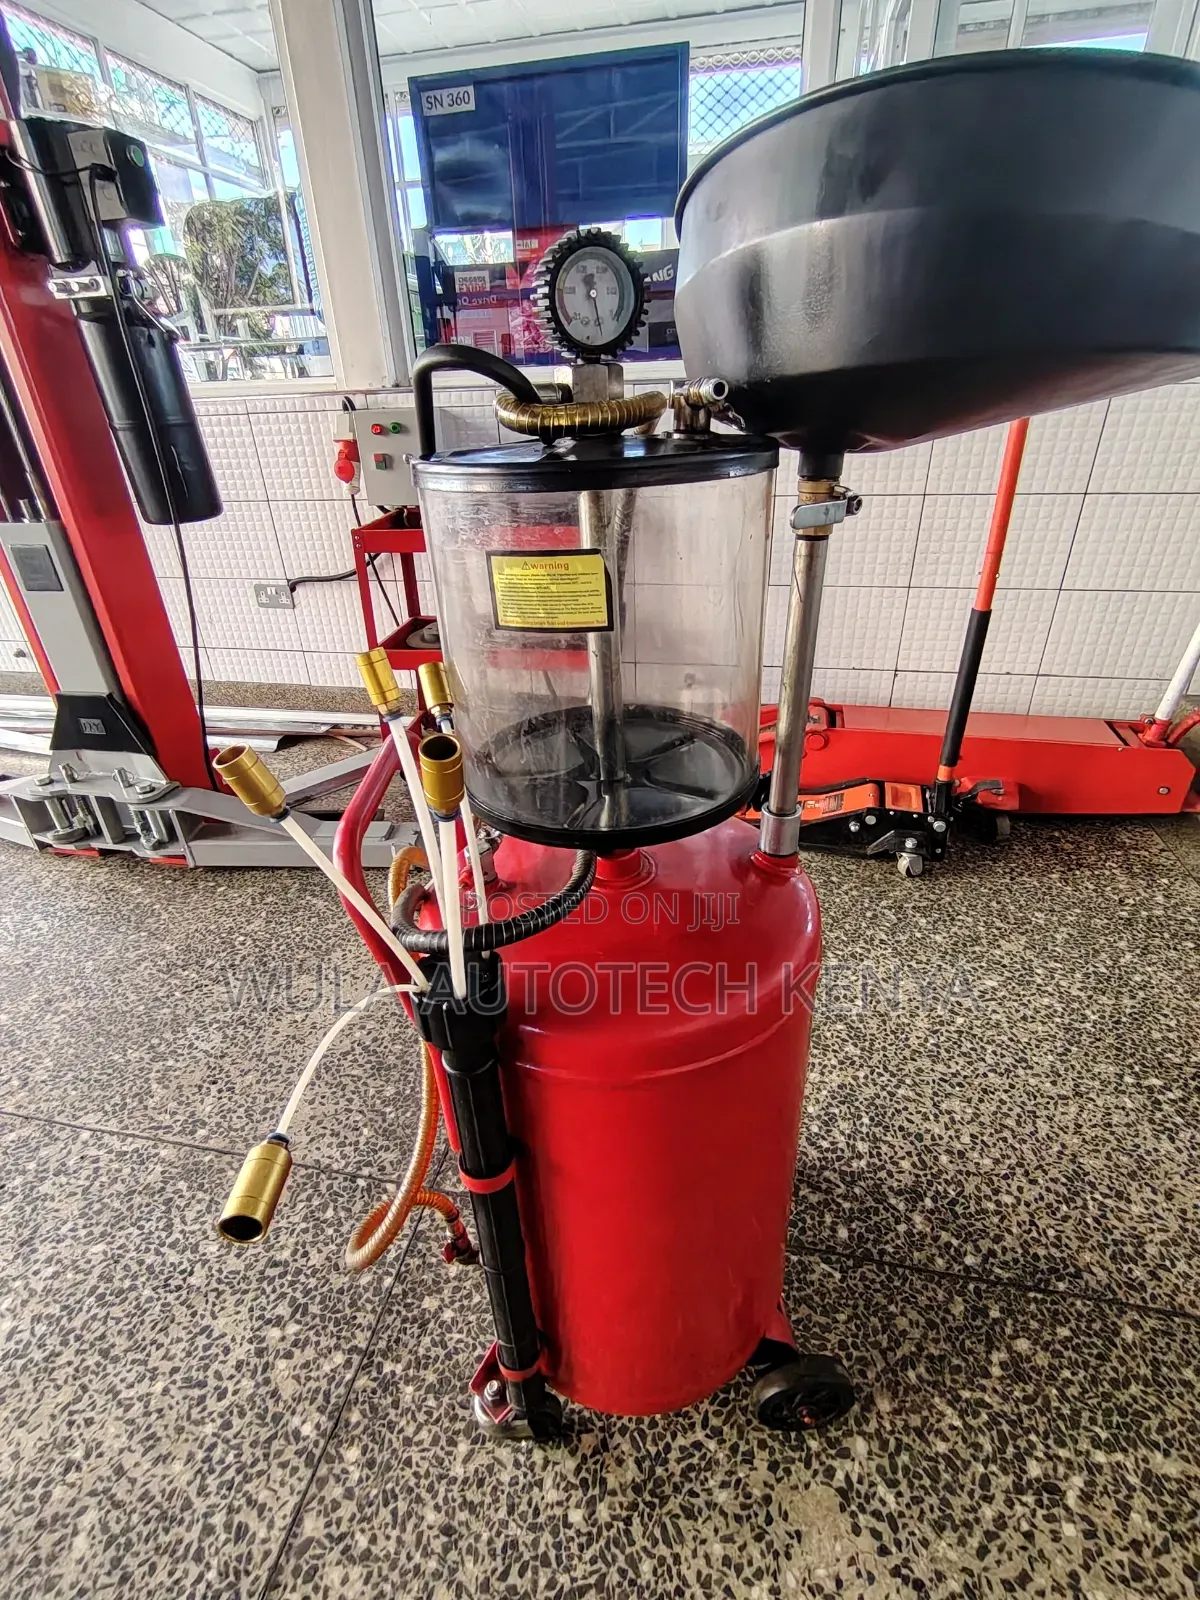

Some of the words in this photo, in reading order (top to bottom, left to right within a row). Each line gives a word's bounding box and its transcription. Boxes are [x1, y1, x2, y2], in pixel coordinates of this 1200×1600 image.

[425, 94, 444, 111] SN
[446, 90, 471, 108] 360
[530, 561, 570, 571] warning
